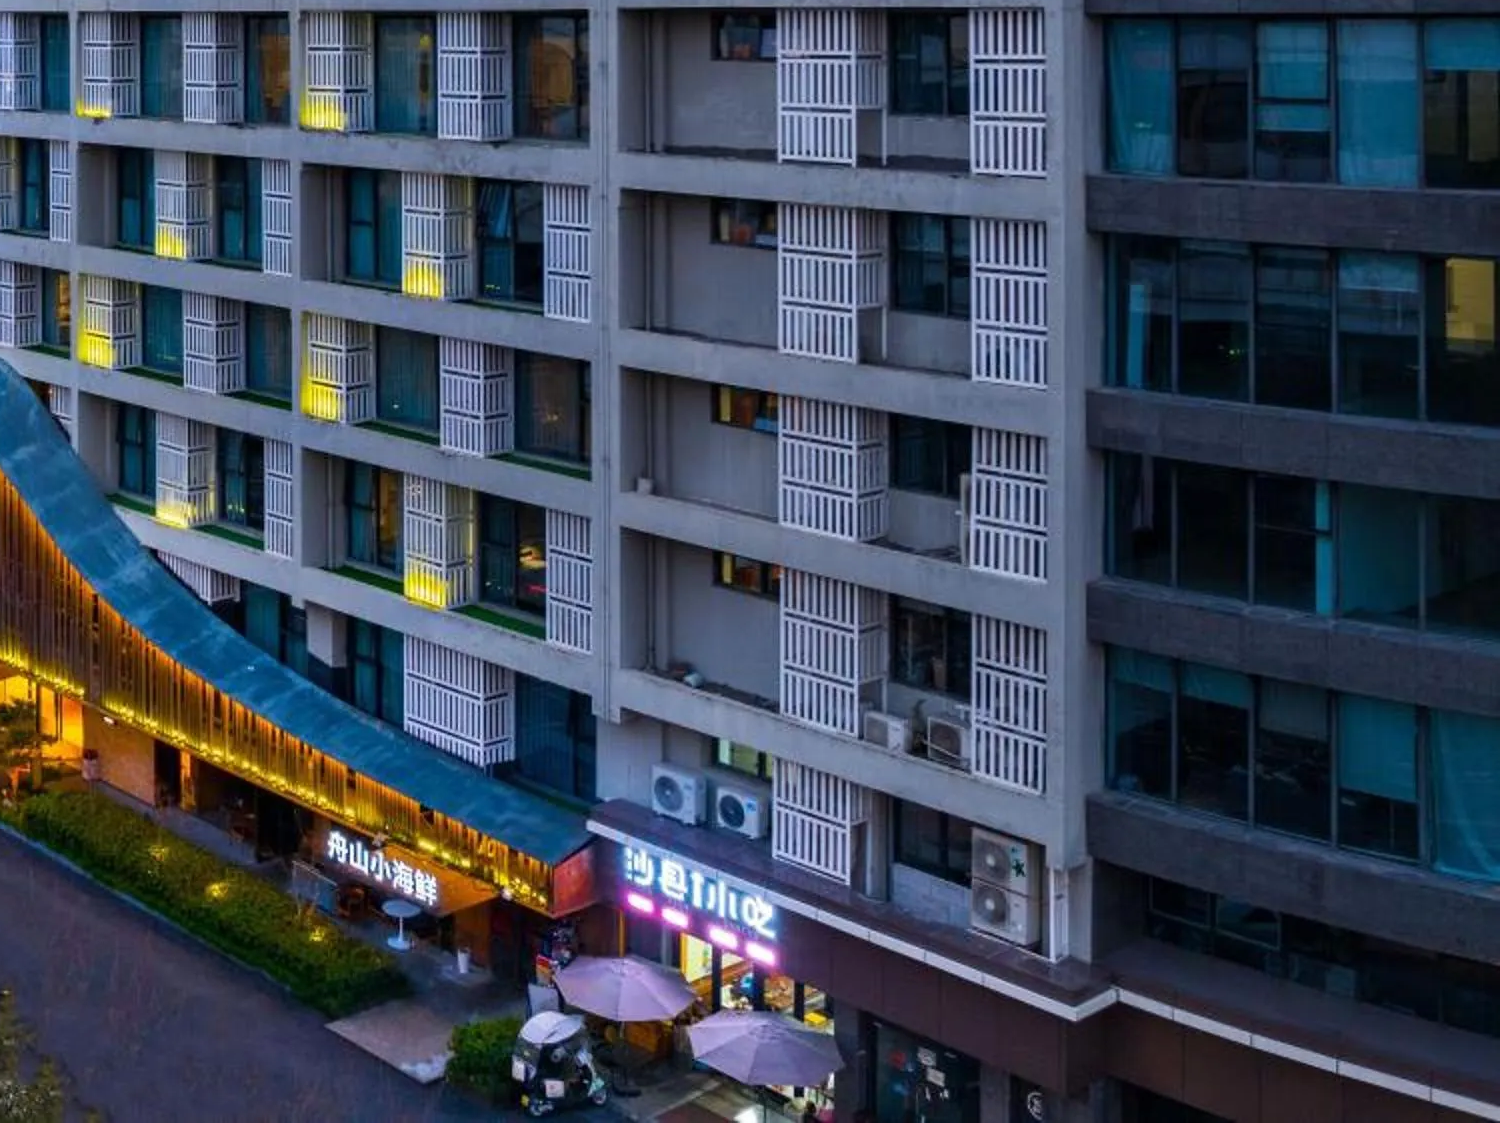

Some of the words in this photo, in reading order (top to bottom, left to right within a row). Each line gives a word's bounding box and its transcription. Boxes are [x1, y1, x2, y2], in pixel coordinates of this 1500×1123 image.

[327, 830, 438, 907] 舟山小海鲜
